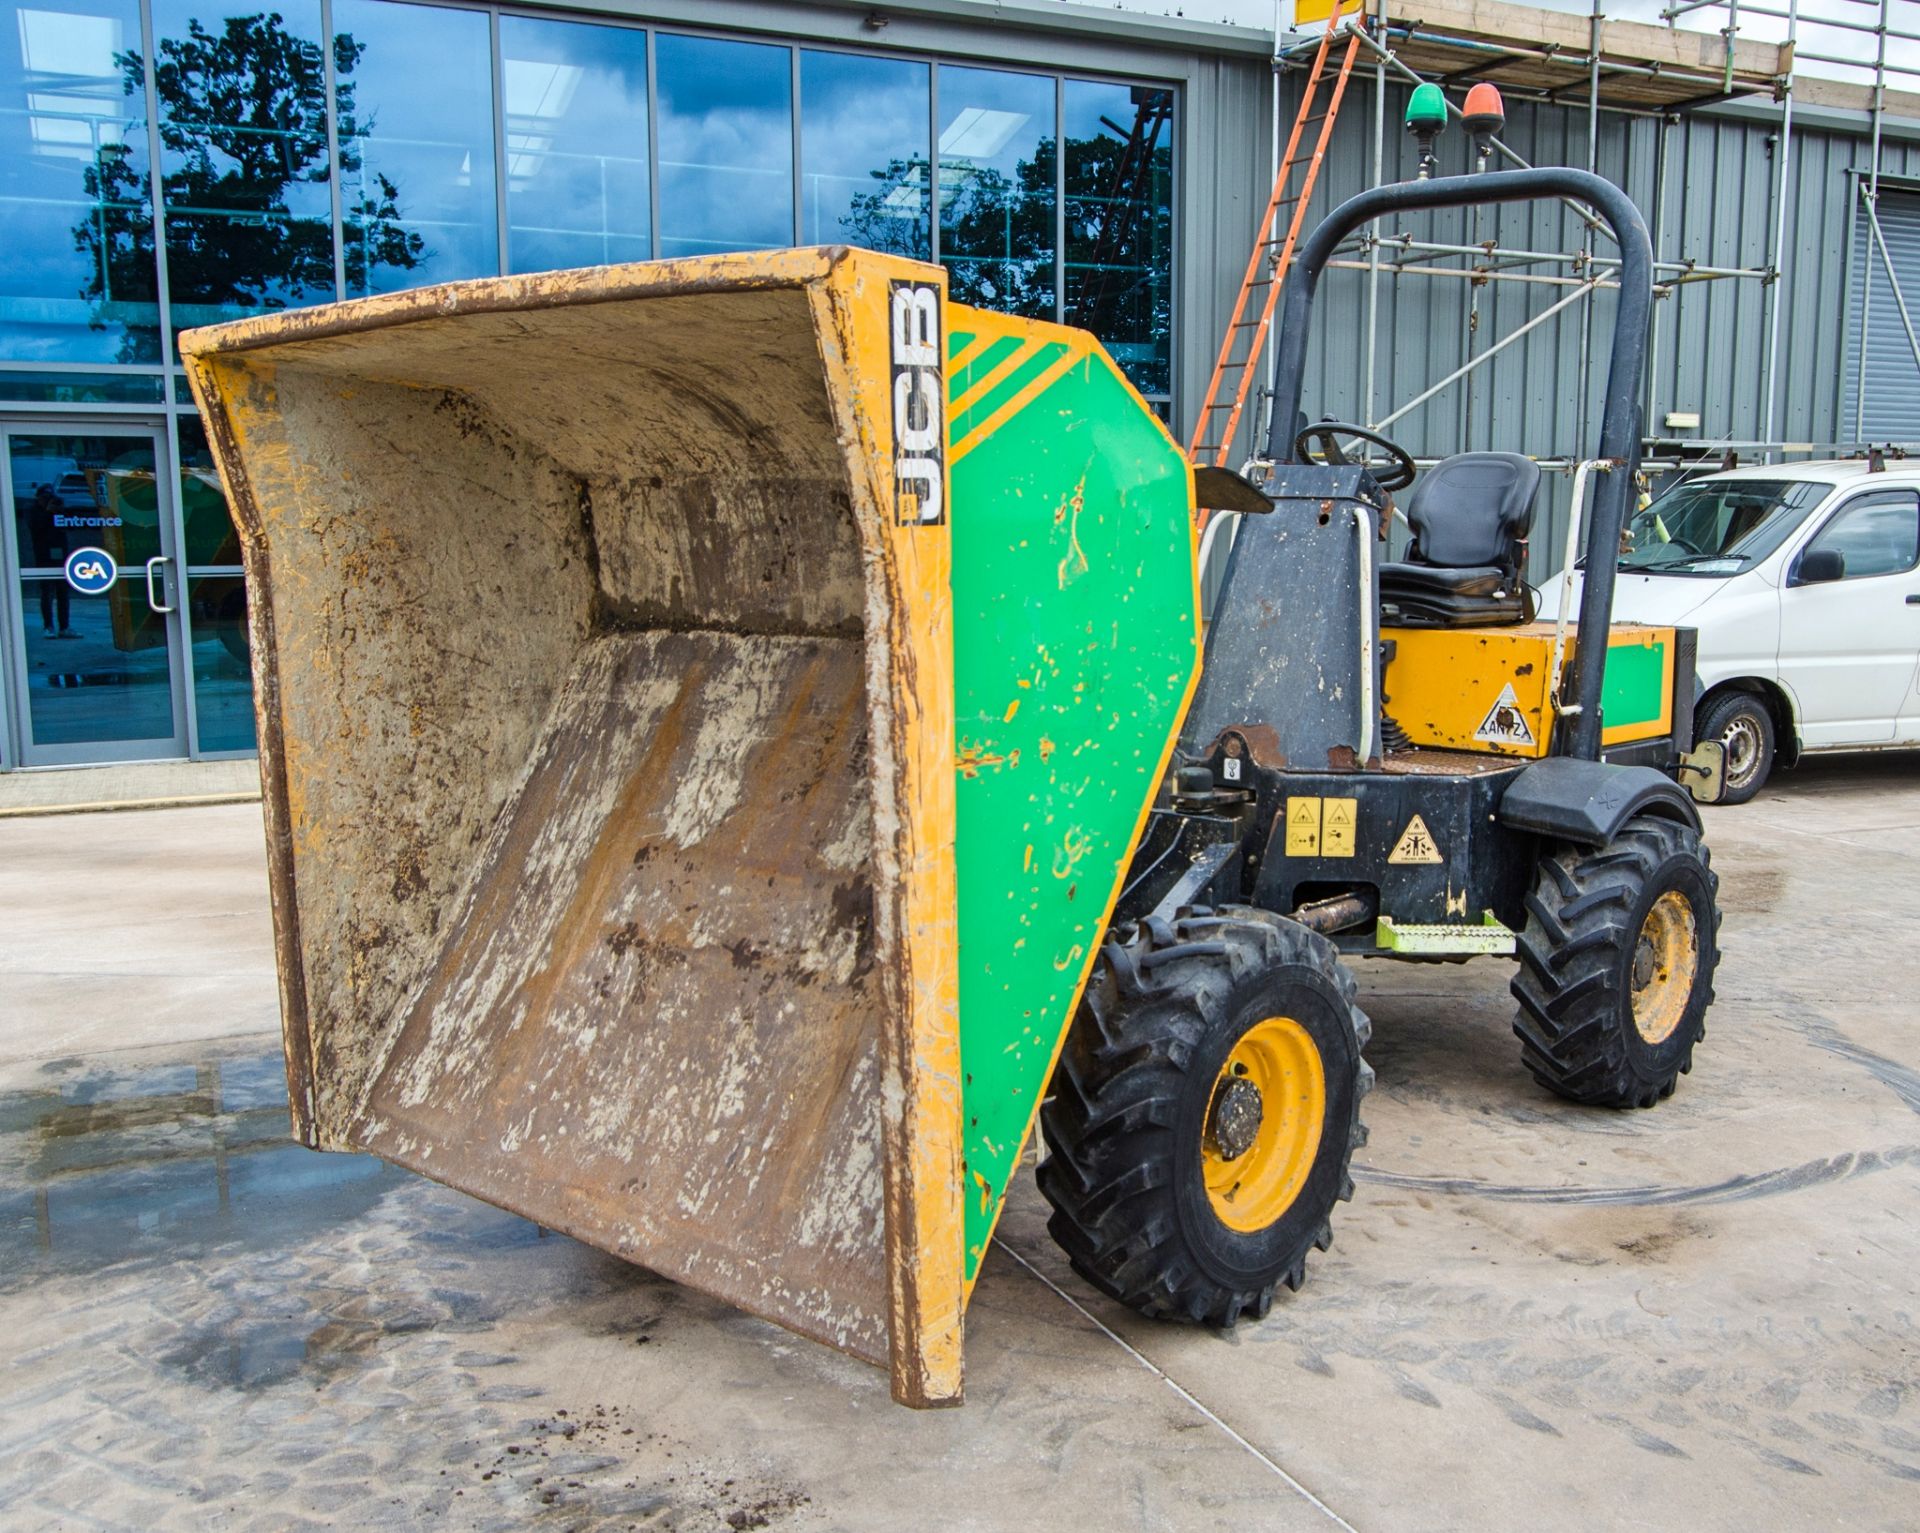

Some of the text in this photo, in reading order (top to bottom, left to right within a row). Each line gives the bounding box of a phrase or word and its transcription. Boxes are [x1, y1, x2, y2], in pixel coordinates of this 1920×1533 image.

[893, 287, 942, 520] JCB
[53, 514, 122, 527] Entrance
[74, 561, 107, 580] GA
